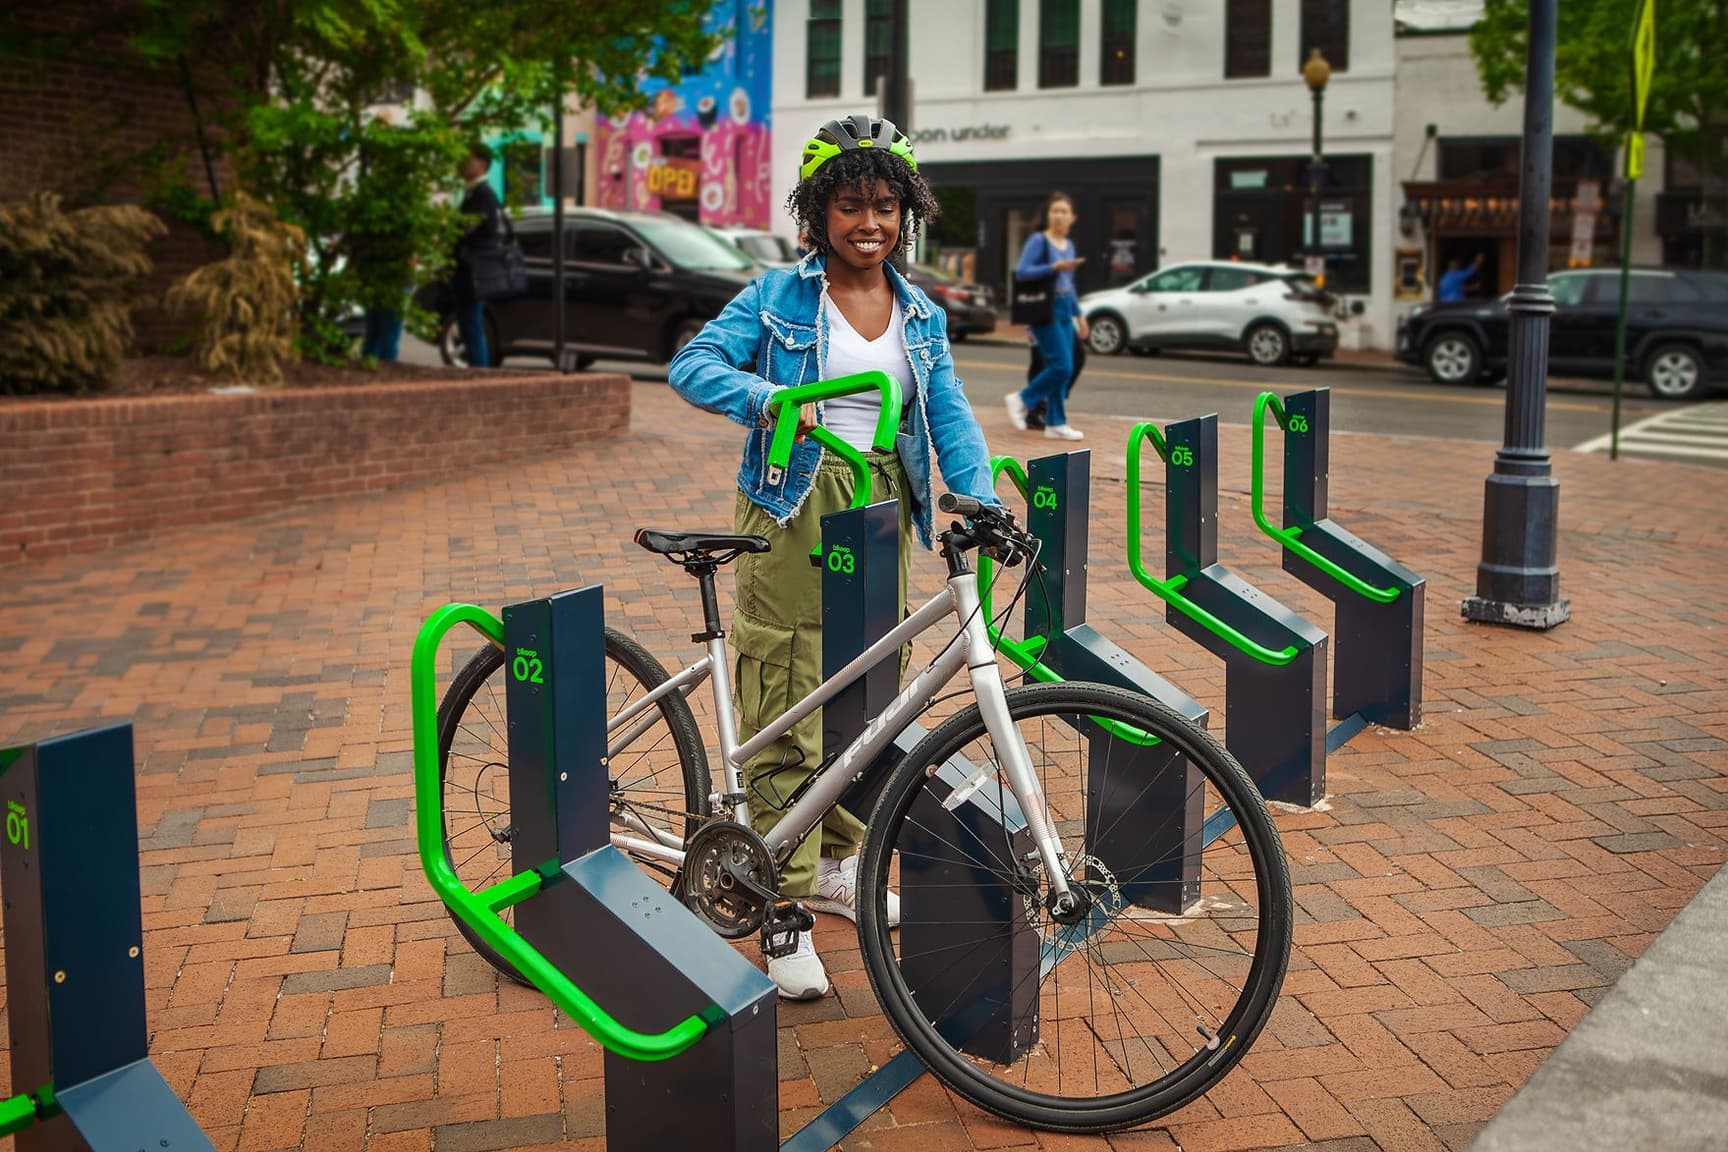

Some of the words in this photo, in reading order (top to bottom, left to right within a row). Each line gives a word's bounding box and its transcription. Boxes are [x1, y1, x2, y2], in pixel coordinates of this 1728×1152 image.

[950, 122, 1011, 142] under
[1289, 419, 1308, 433] 06
[1171, 451, 1193, 467] 05
[1033, 491, 1057, 510] 04
[828, 551, 855, 574] 03
[512, 655, 544, 684] 02
[6, 812, 29, 850] 01
